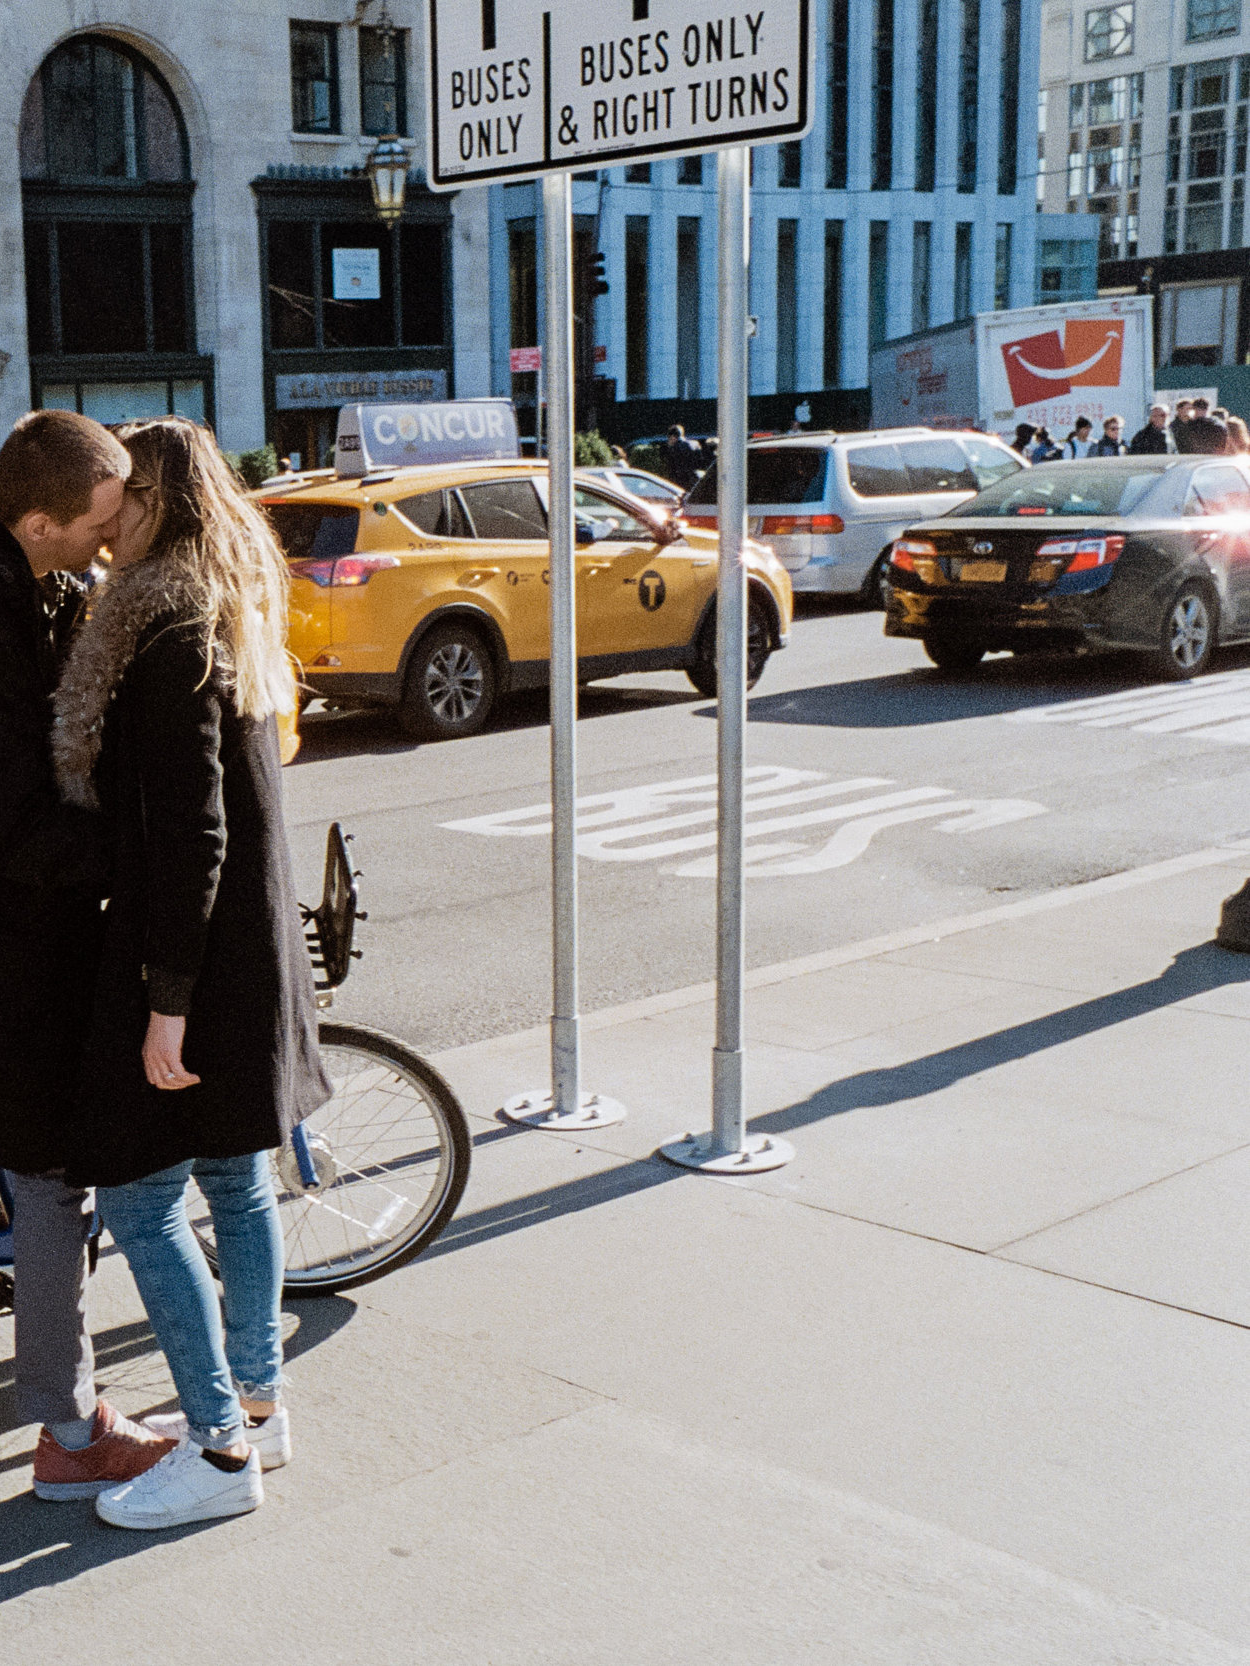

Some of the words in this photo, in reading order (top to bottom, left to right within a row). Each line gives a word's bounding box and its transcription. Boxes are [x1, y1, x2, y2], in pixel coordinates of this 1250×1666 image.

[581, 30, 669, 86] BUSES
[684, 11, 764, 67] ONLY
[451, 57, 531, 110] BUSES
[558, 105, 579, 146] &
[593, 87, 676, 140] RIGHT
[688, 67, 789, 124] TURNS
[459, 114, 523, 160] ONLY
[373, 409, 506, 446] CONCUR
[642, 574, 663, 609] T
